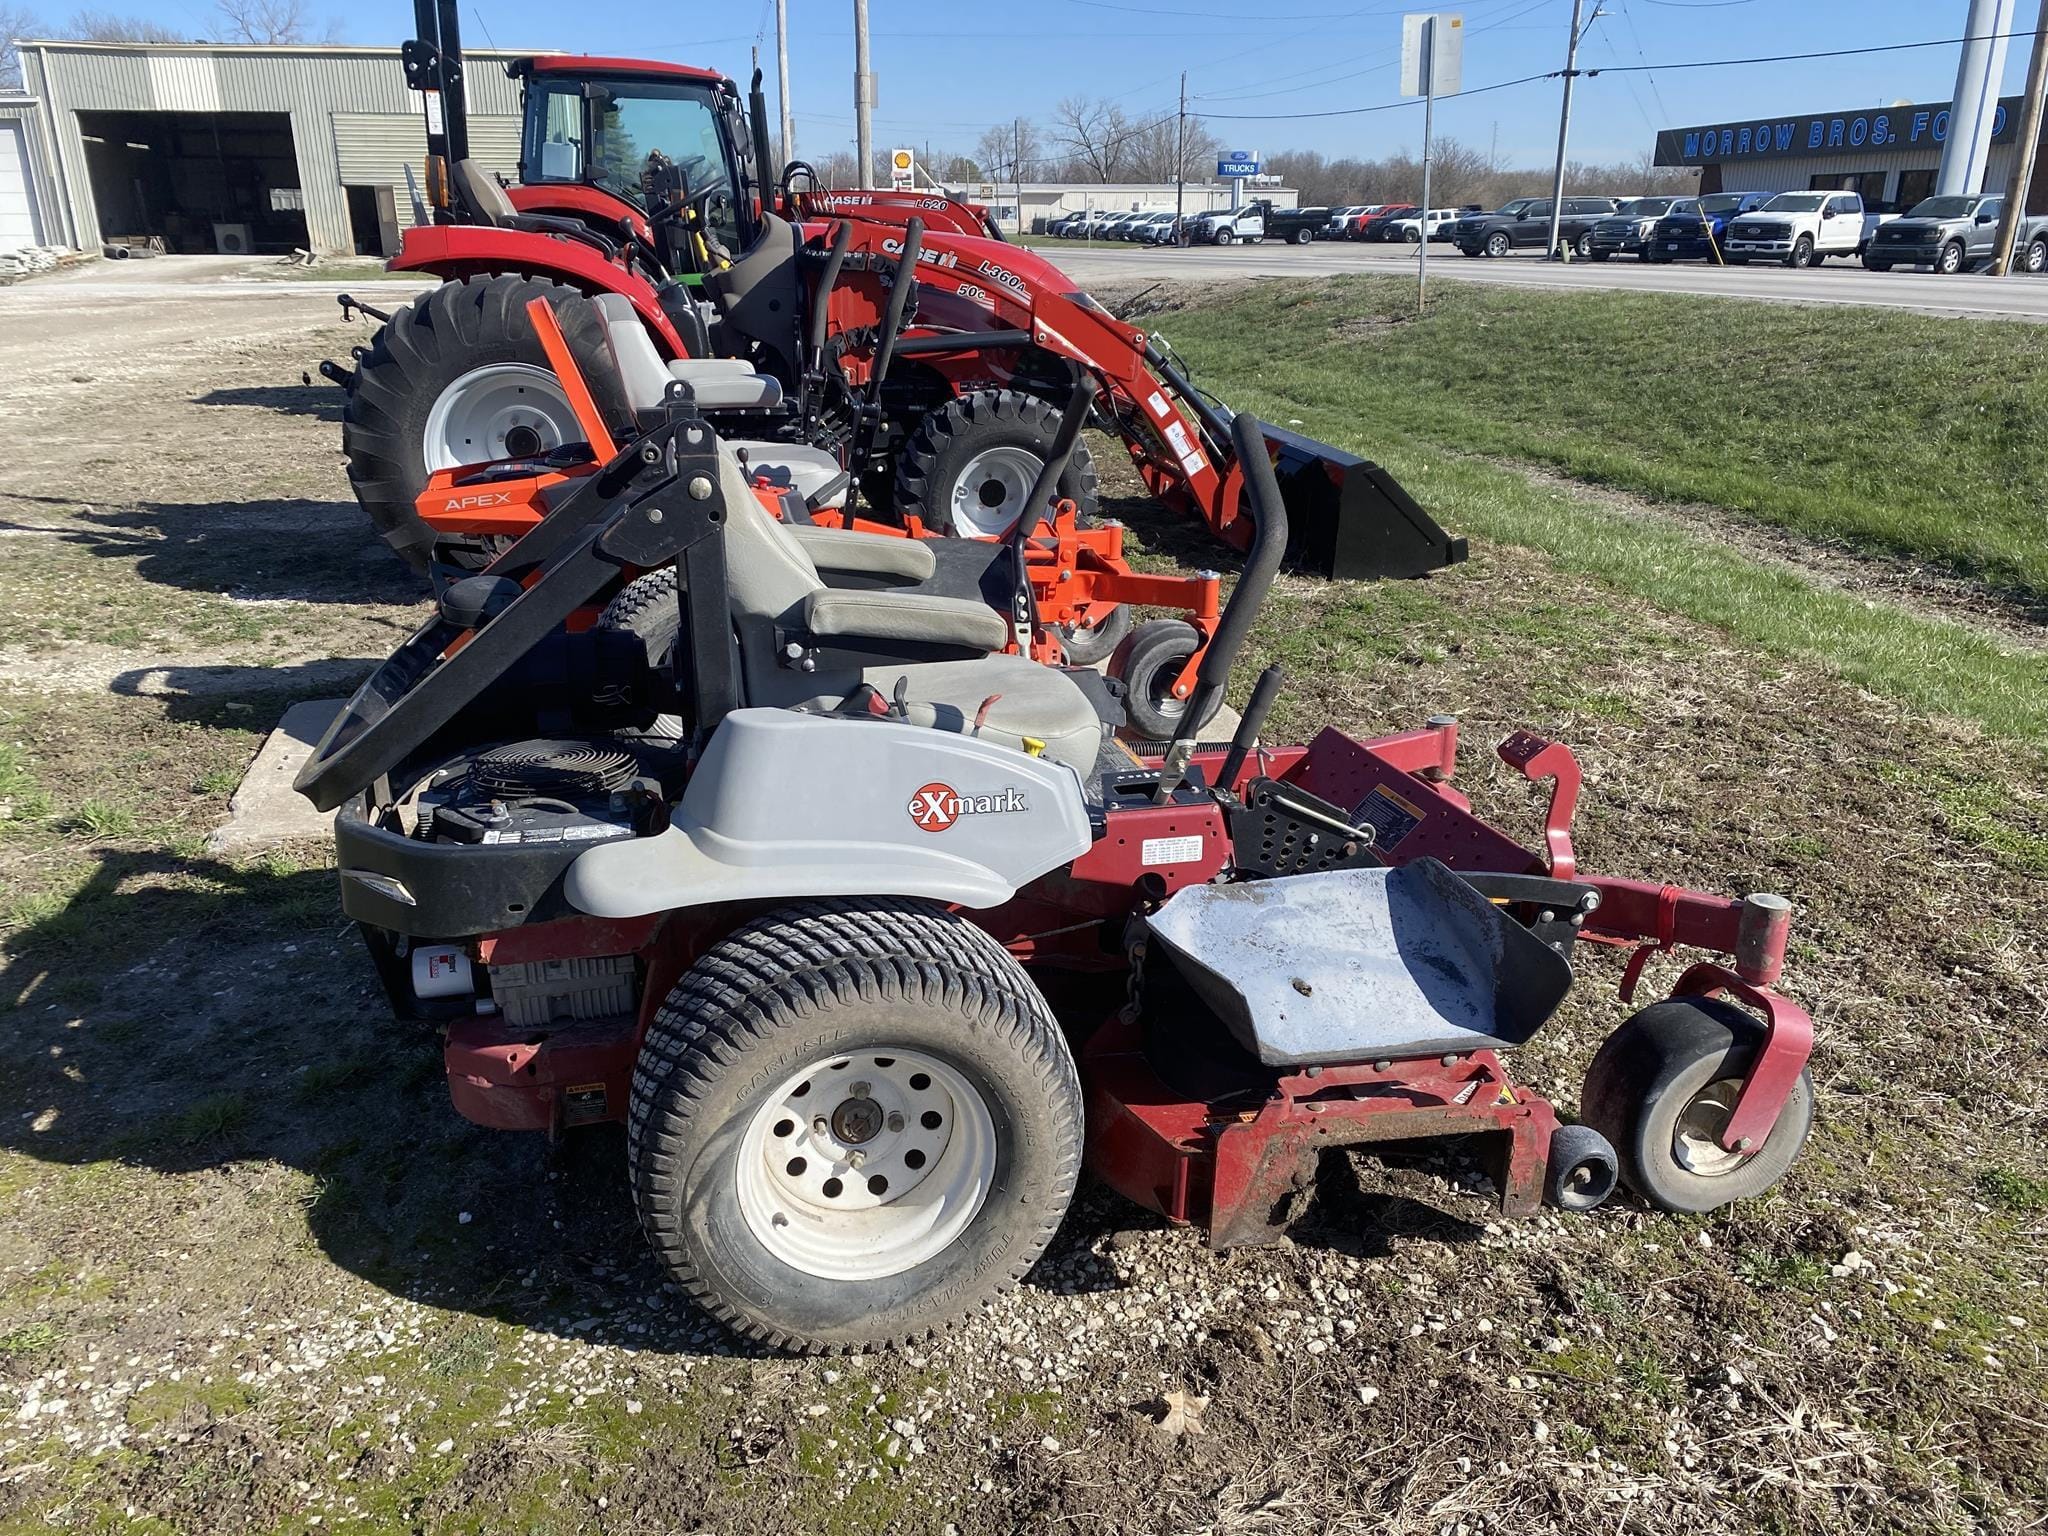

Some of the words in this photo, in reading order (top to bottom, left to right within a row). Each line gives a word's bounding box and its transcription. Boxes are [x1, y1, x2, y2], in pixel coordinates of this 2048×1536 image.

[1683, 123, 1796, 158] MORROW
[1807, 115, 1896, 149] BROS.
[1911, 105, 2007, 142] FOD
[1223, 164, 1256, 173] TRUCKS
[915, 199, 948, 212] L620
[977, 260, 1027, 293] L360A
[445, 491, 512, 512] APEX
[907, 787, 1025, 825] eXmark
